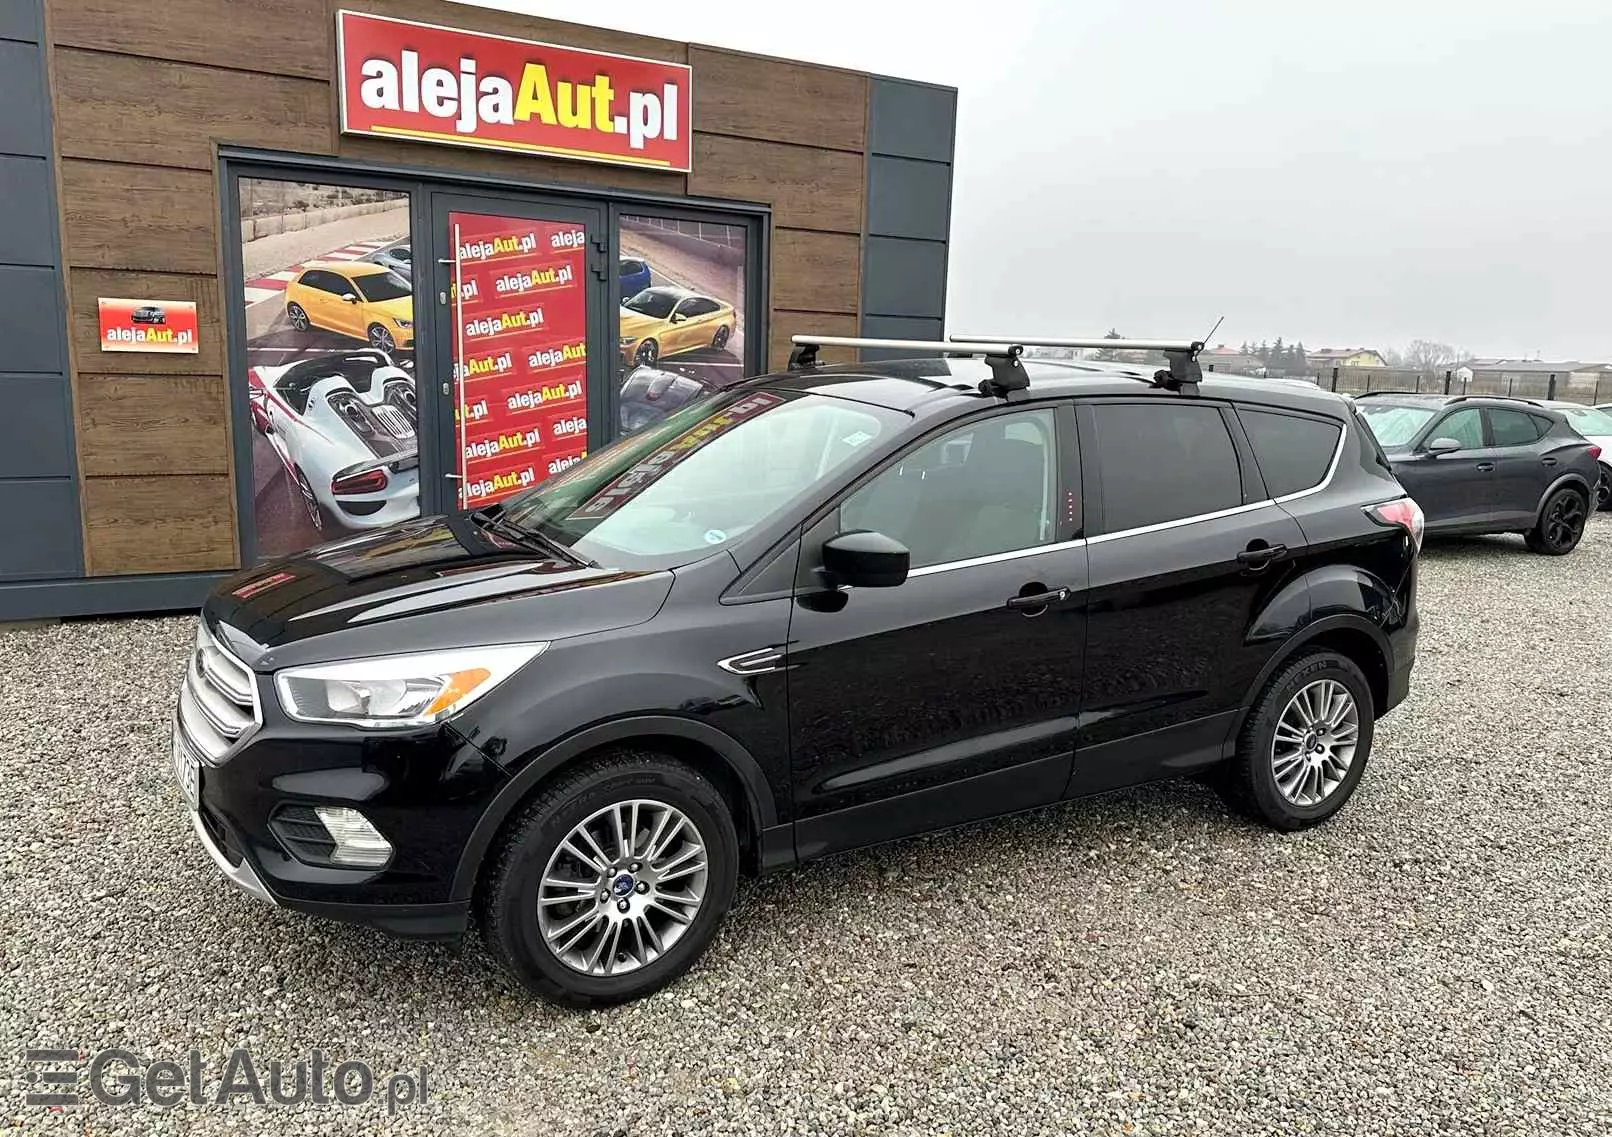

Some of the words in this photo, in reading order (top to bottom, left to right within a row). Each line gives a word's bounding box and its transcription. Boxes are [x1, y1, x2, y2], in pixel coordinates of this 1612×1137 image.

[360, 49, 678, 149] alejaAut.pl
[459, 233, 537, 260] alejaAut.pl
[495, 265, 573, 294] alejaAut.pl
[107, 326, 193, 345] alejaAut.pl
[465, 308, 544, 336] alejaAut.pl
[507, 380, 583, 410] alejaAut.pl
[464, 428, 541, 459] alejaAut.pl
